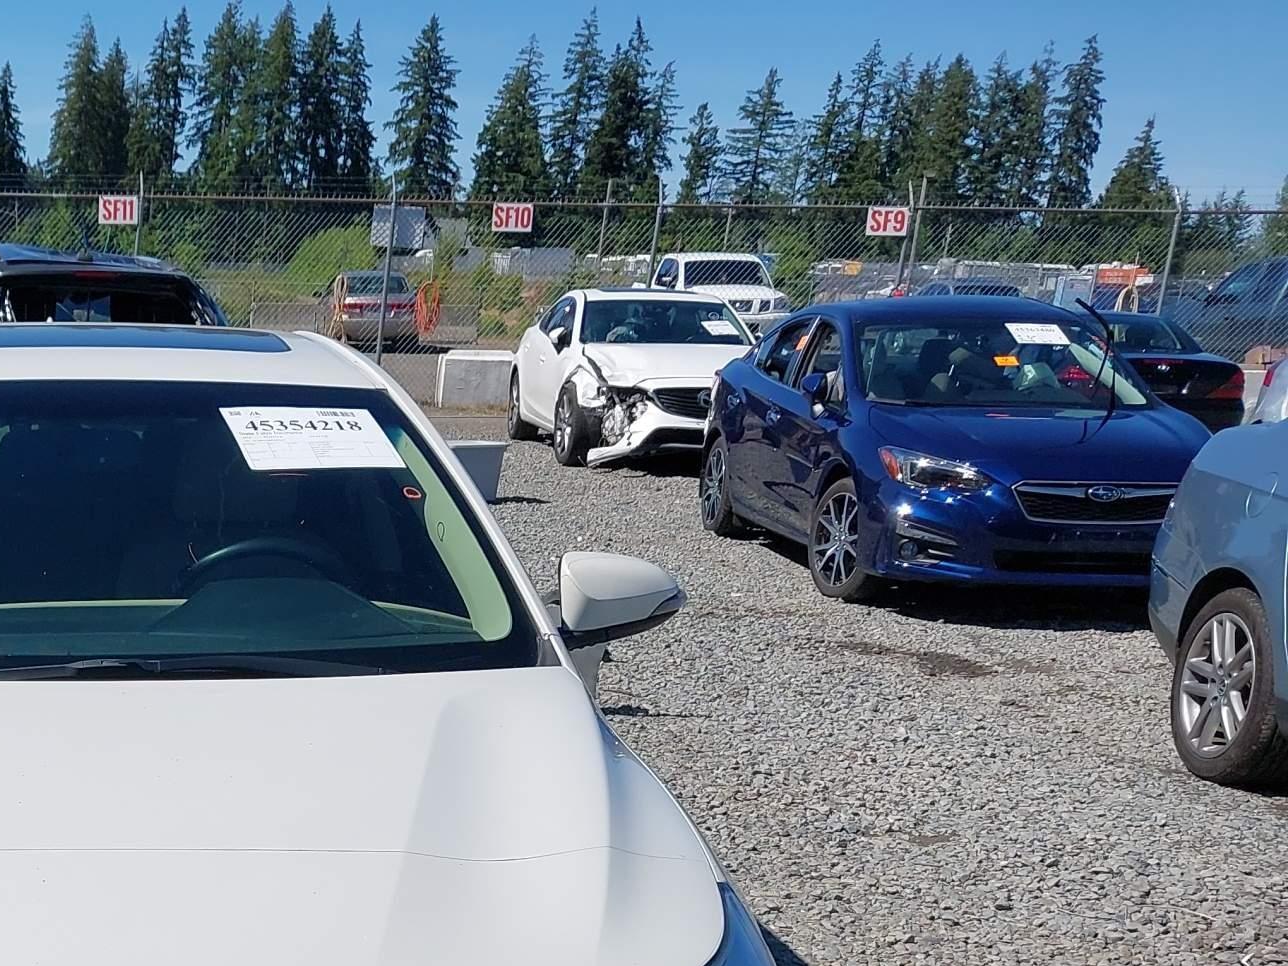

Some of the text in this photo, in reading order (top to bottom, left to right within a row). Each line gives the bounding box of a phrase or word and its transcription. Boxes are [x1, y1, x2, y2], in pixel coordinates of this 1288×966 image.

[102, 199, 134, 221] SF11
[494, 206, 531, 228] SF10
[870, 210, 906, 232] SF9
[245, 419, 363, 432] 45354218
